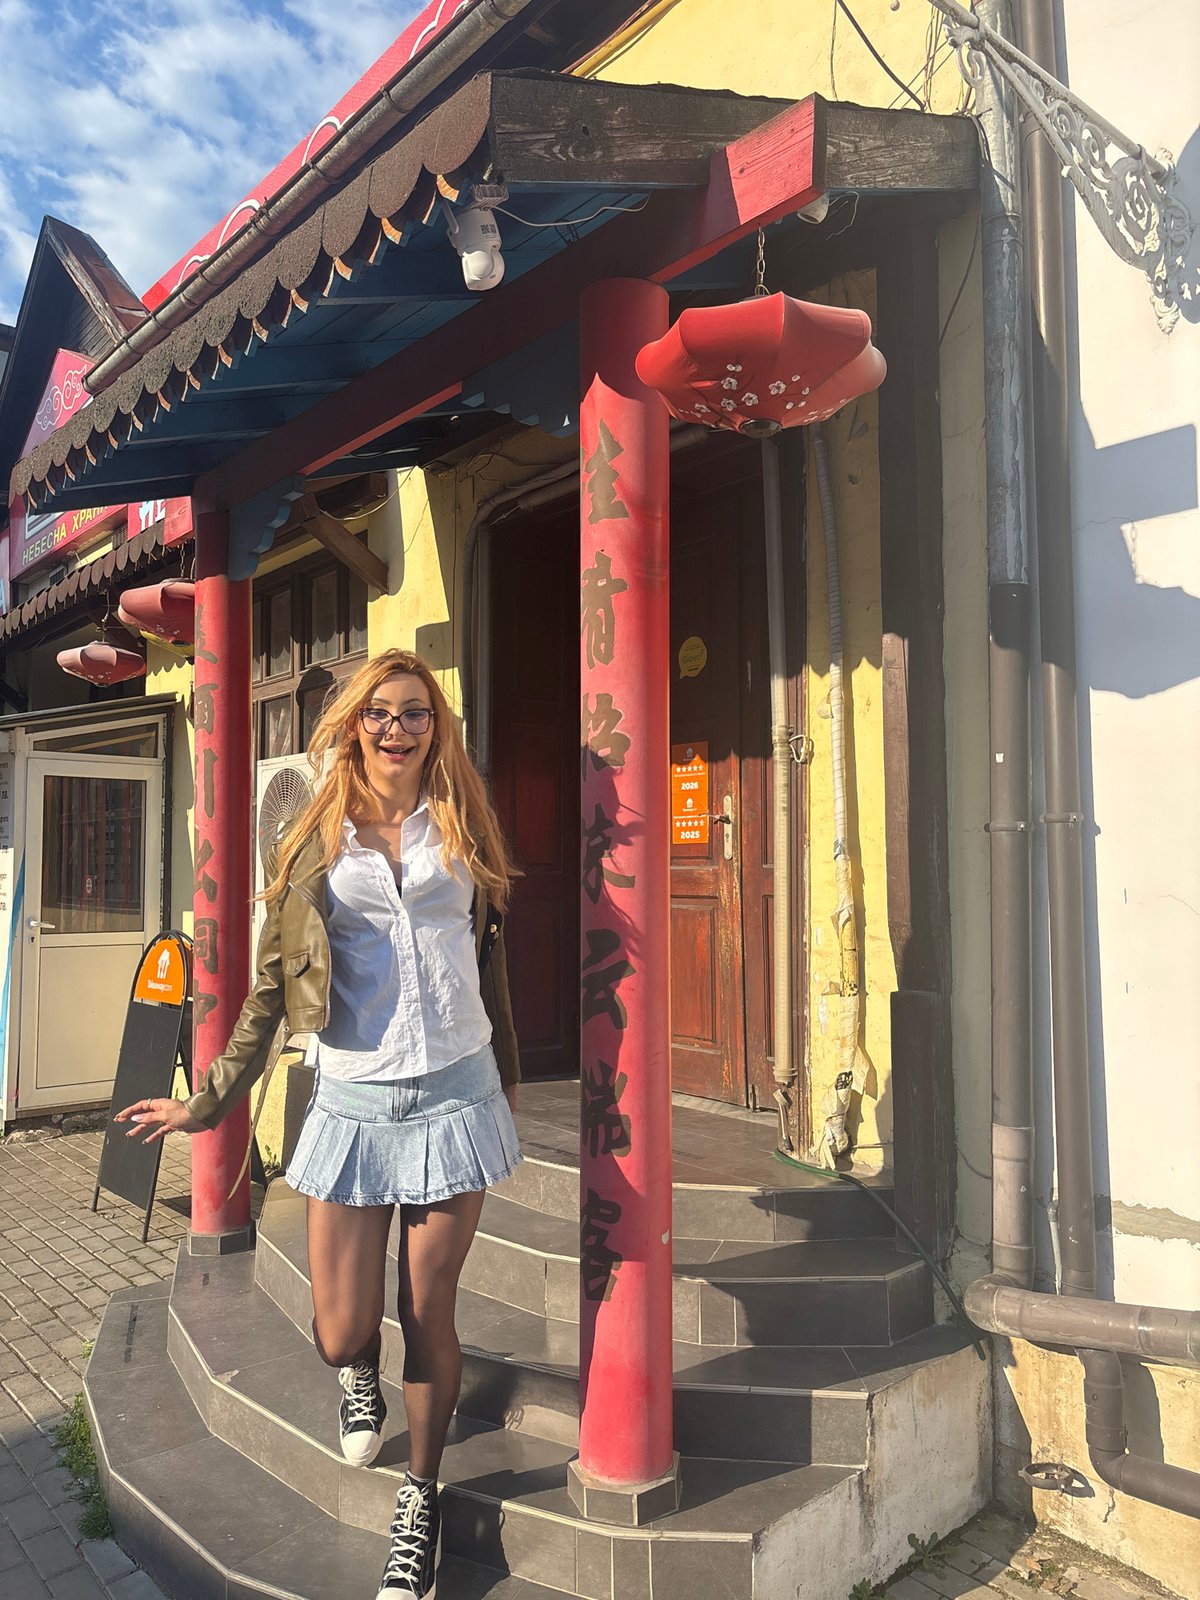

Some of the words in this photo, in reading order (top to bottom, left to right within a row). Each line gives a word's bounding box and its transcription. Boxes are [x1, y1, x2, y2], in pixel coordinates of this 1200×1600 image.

[22, 522, 67, 566] НЕБЕСНА
[681, 782, 699, 791] 2026
[680, 831, 701, 840] 2025
